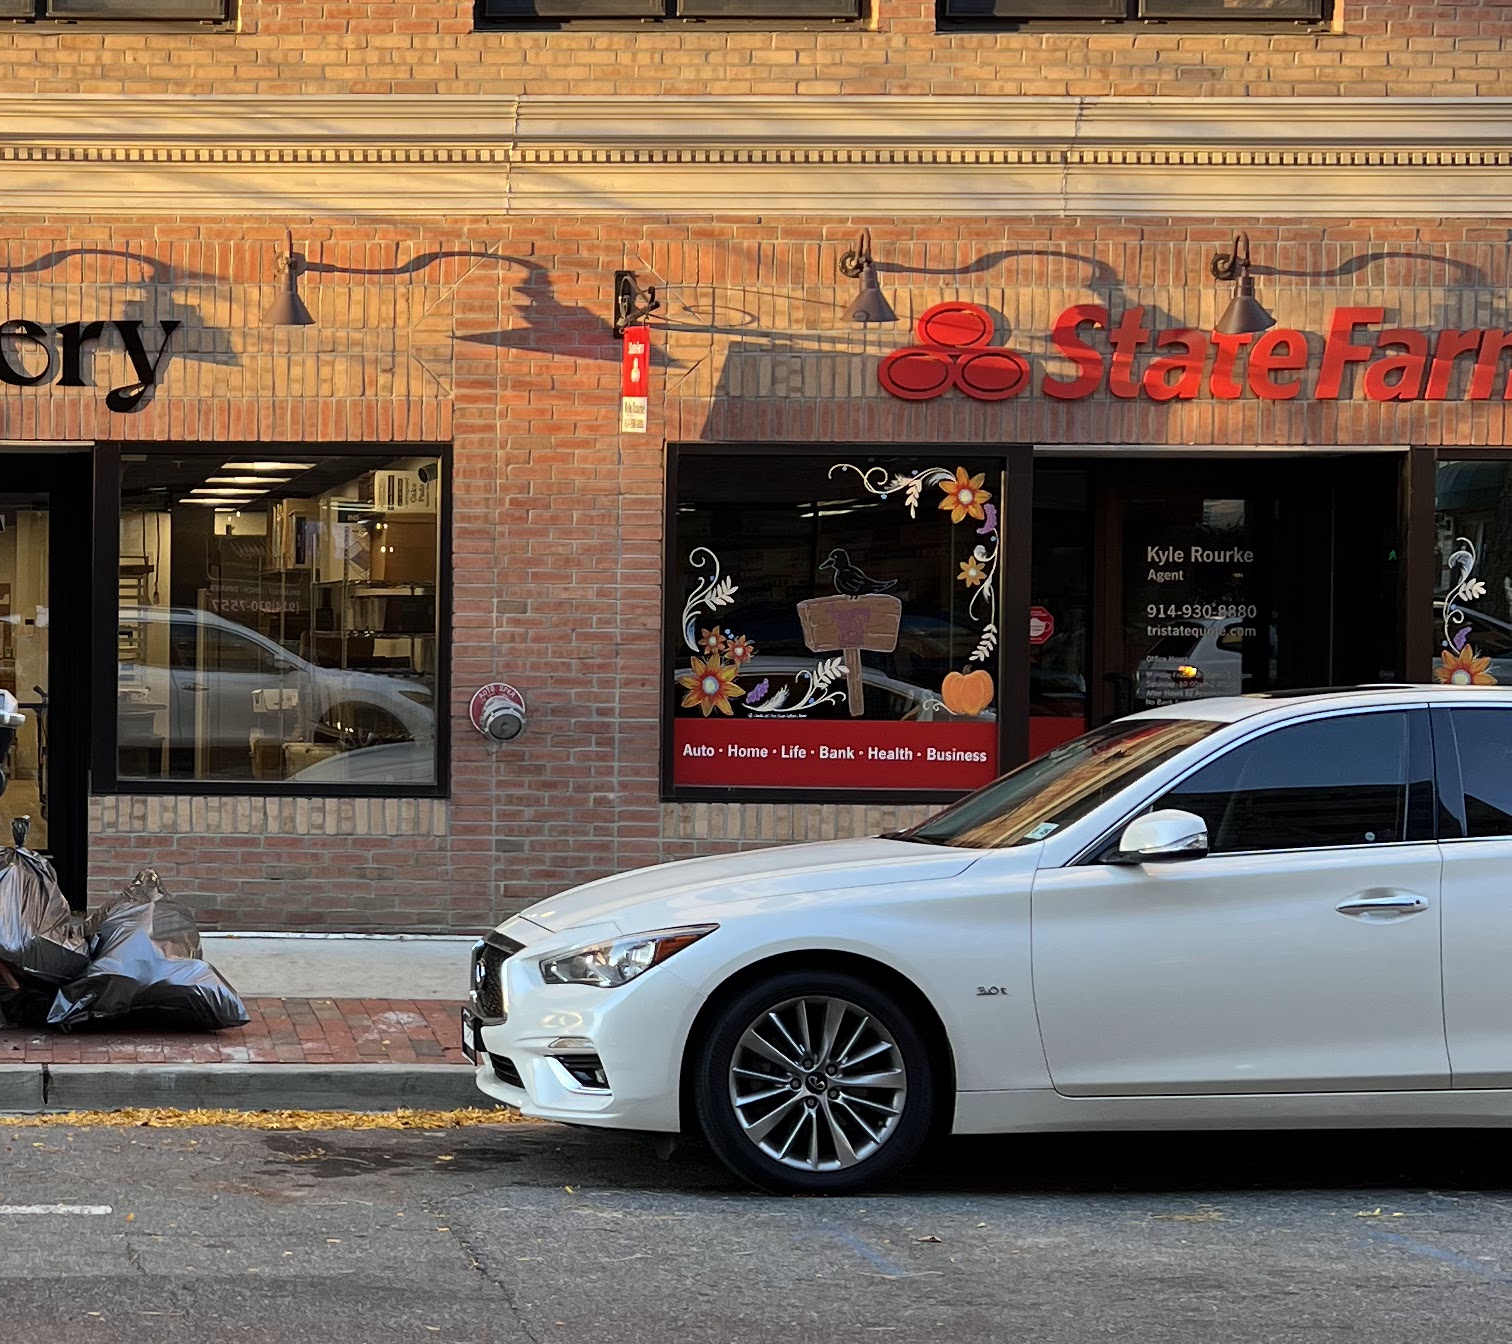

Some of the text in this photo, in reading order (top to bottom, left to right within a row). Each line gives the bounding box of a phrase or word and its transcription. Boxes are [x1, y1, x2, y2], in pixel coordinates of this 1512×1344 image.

[1043, 303, 1308, 402] State
[1147, 546, 1254, 566] Kyle Rourke
[1147, 568, 1184, 583] Agent
[1146, 604, 1257, 618] 914-930-8880
[683, 743, 987, 762] Auto Home Life Bank Health Business
